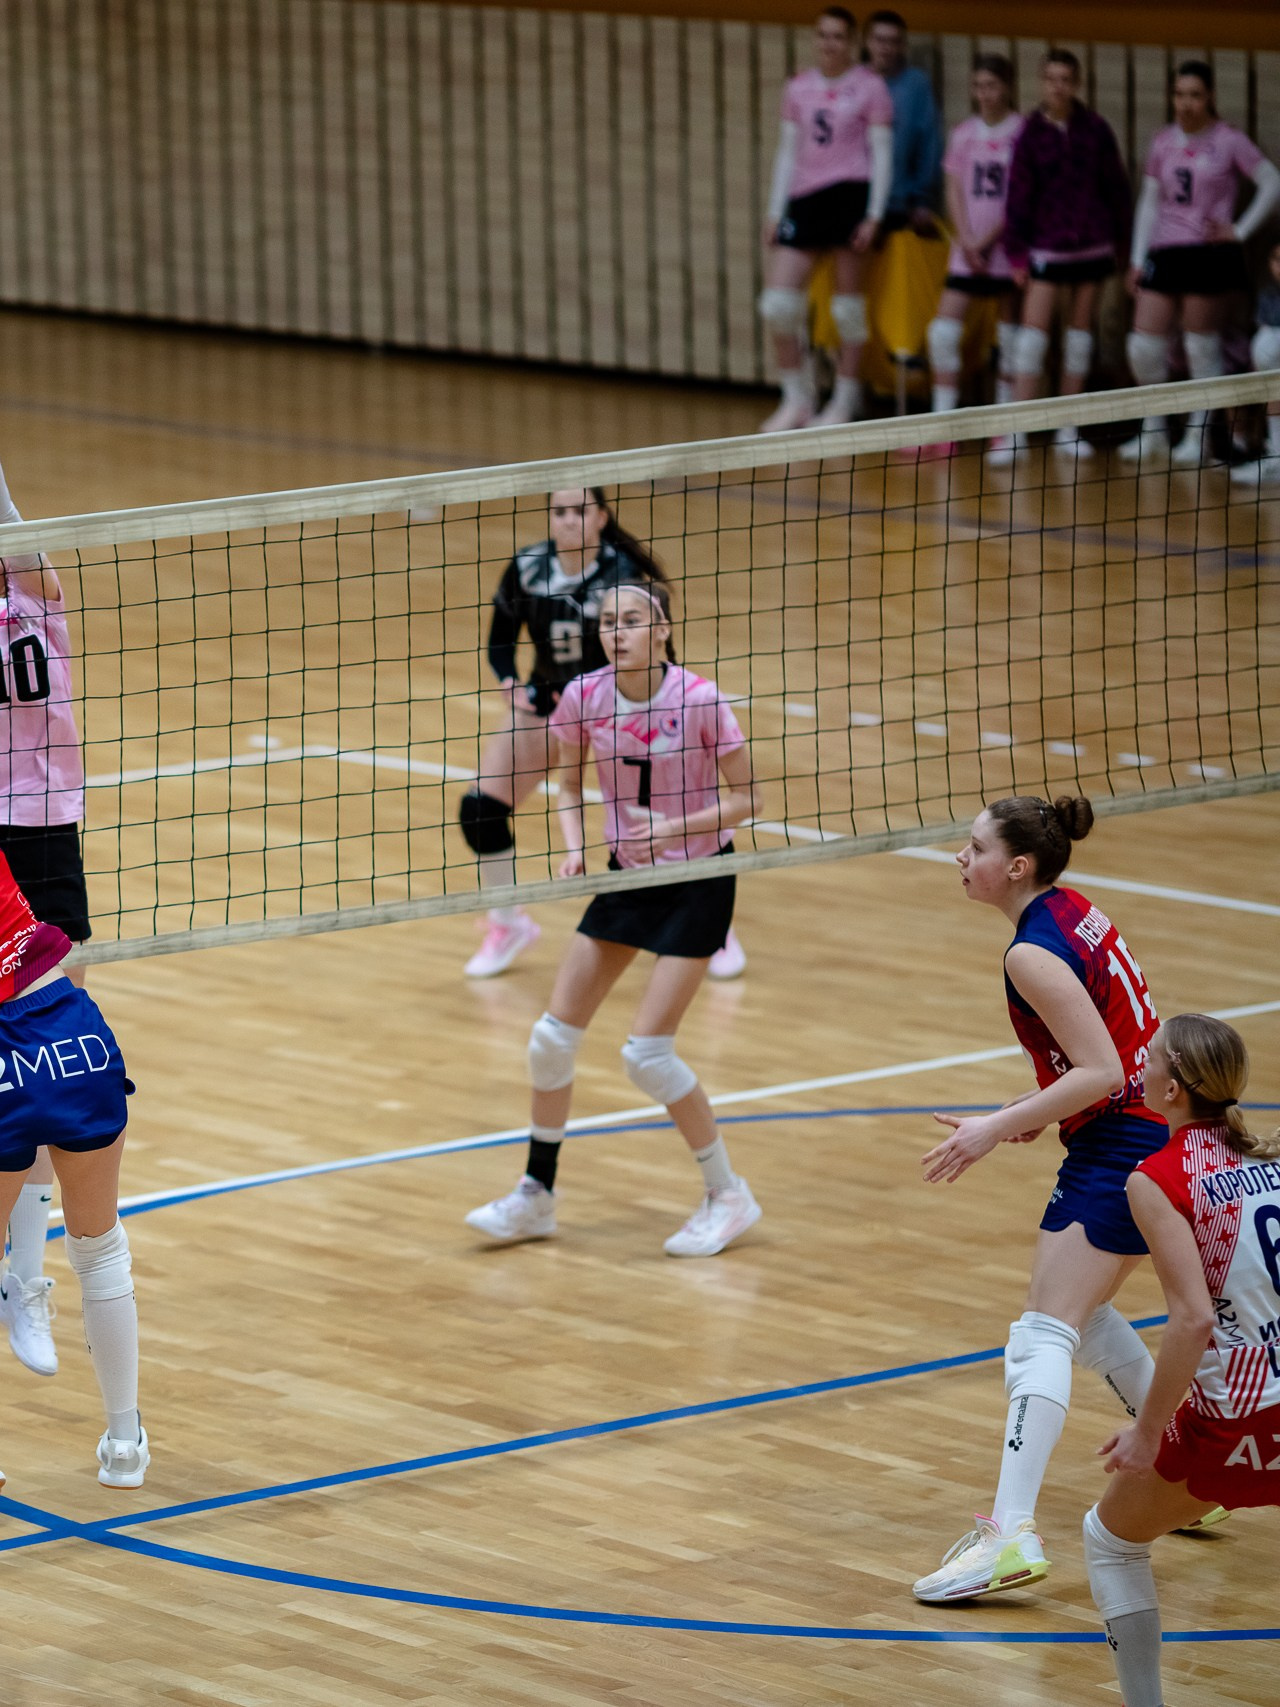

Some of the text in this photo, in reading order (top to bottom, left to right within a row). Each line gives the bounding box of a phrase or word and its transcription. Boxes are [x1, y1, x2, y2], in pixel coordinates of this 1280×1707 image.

[813, 109, 832, 146] 5
[973, 161, 1006, 198] 19
[549, 620, 582, 664] 9
[623, 757, 652, 807] 7
